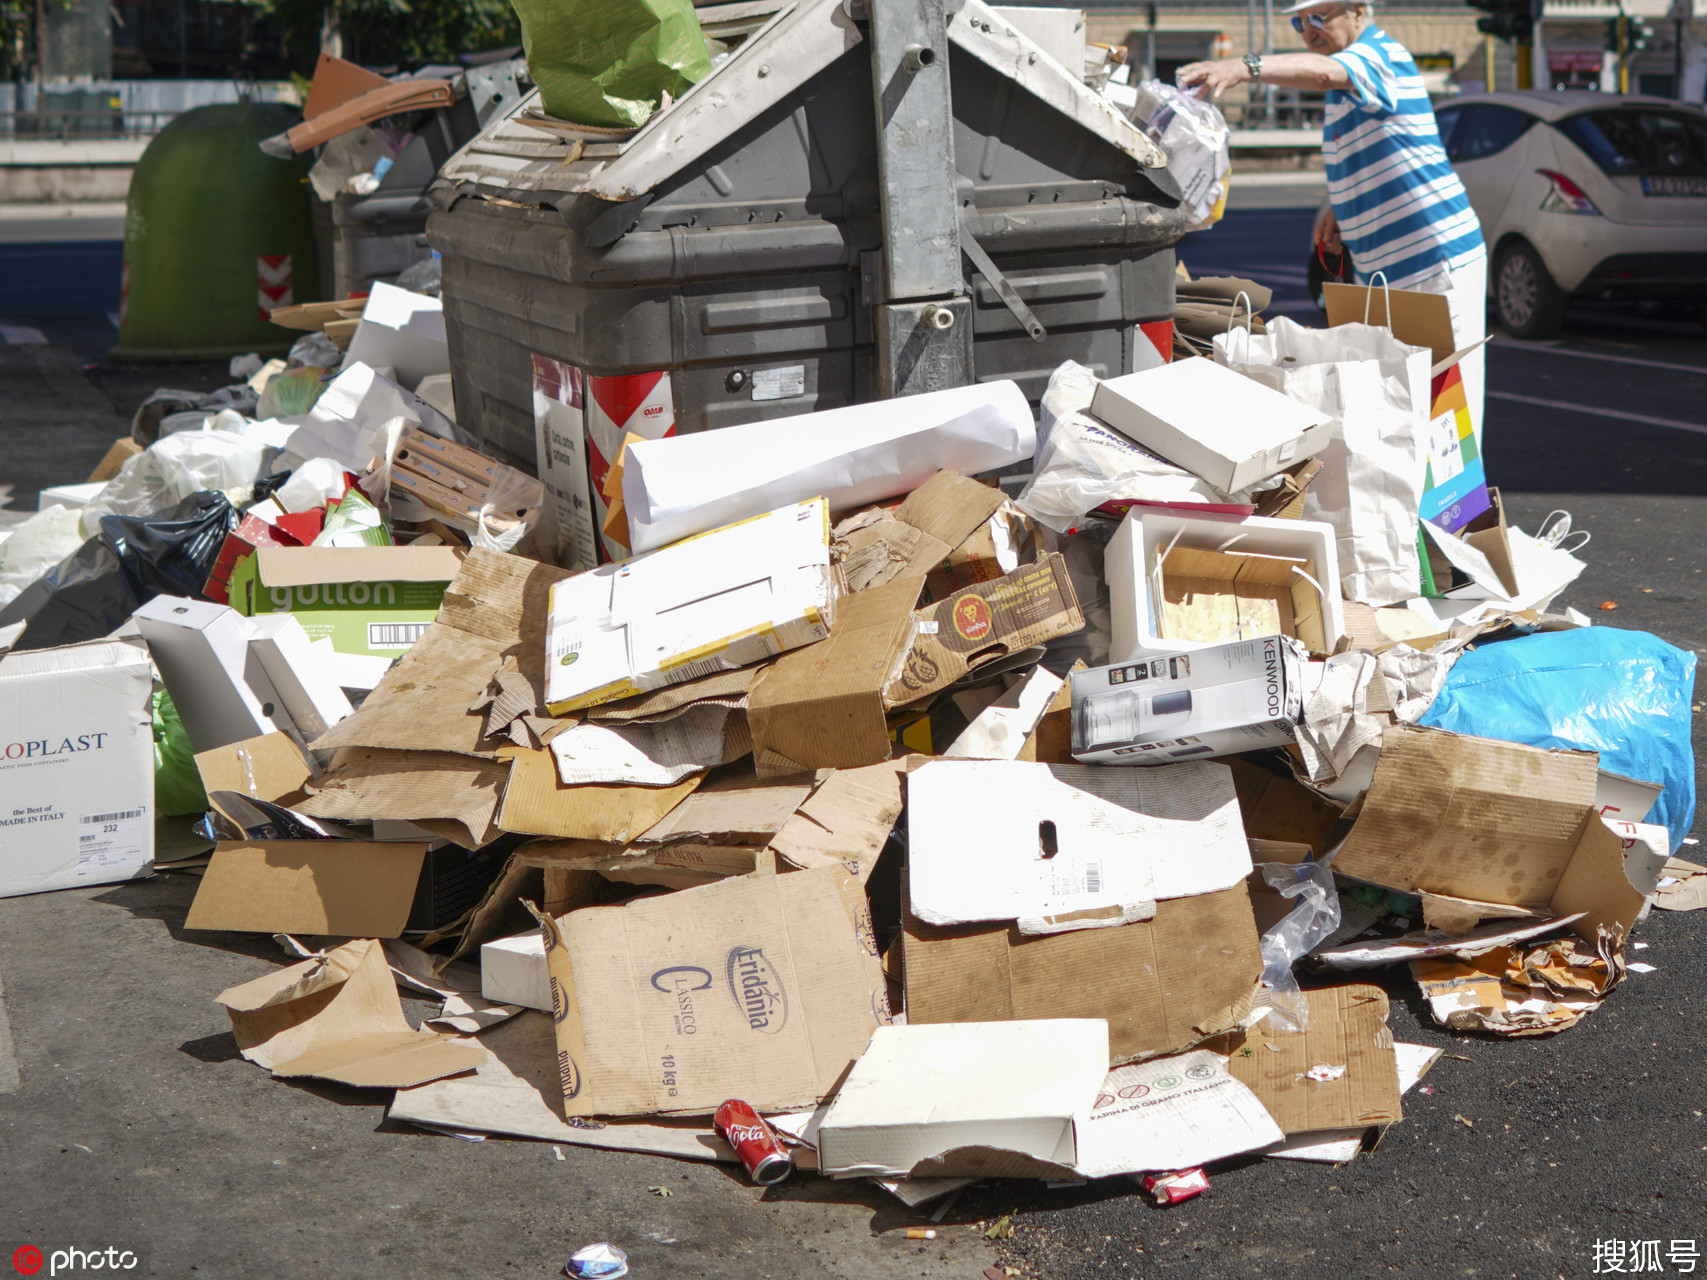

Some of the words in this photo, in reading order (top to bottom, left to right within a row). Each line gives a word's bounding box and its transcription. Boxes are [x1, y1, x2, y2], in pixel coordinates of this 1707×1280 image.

[965, 621, 987, 634] simba
[1263, 639, 1280, 717] KENWOOD
[0, 732, 108, 761] OPLAST
[40, 812, 66, 822] ITALY
[103, 824, 118, 833] 232
[736, 948, 771, 1031] Eridania
[661, 1054, 676, 1069] 10
[662, 1070, 678, 1086] kg
[1090, 1108, 1129, 1121] FARINA
[1129, 1104, 1140, 1112] DI
[1142, 1093, 1181, 1108] GRANO
[1184, 1078, 1232, 1096] ITALIANO
